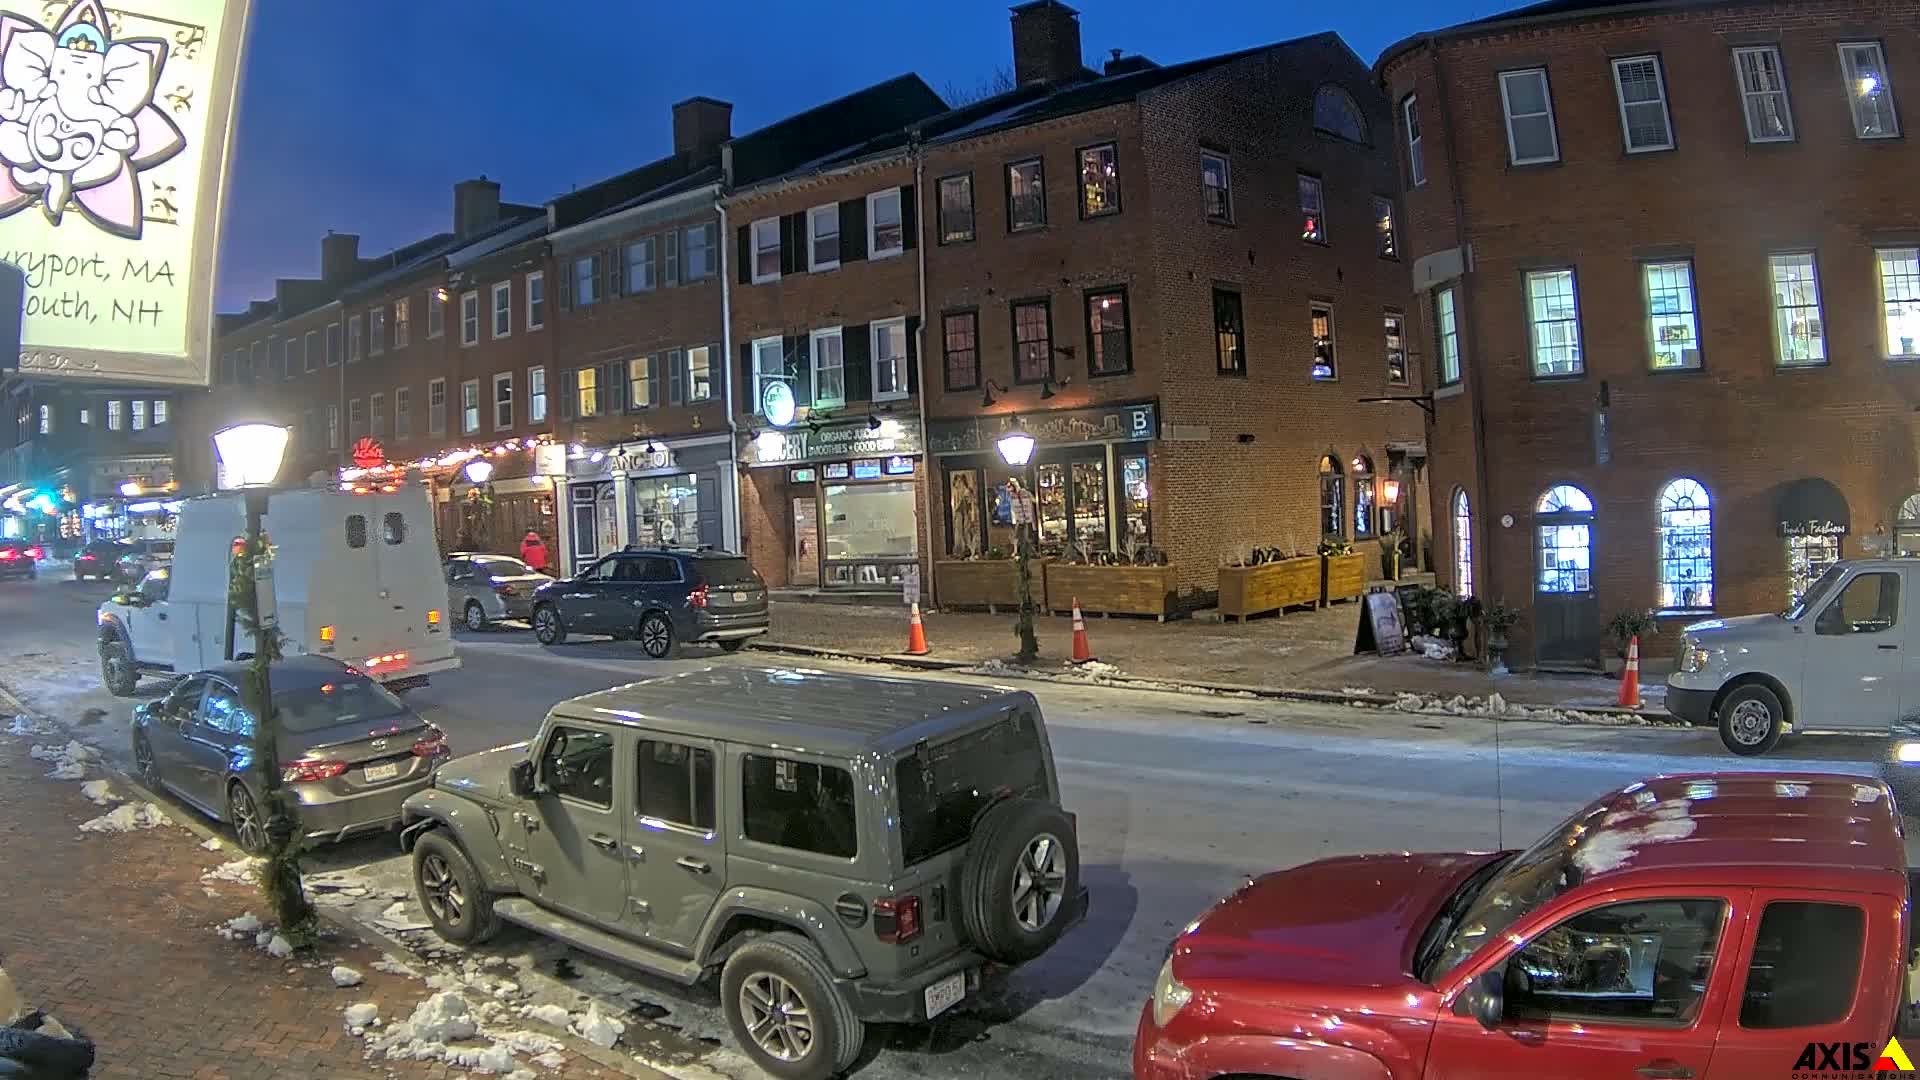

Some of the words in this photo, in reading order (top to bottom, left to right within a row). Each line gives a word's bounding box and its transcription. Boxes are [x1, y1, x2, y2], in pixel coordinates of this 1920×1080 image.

[122, 258, 174, 286] MA
[112, 298, 163, 327] NH
[820, 429, 853, 442] ORGANIC
[854, 441, 876, 453] GOOD
